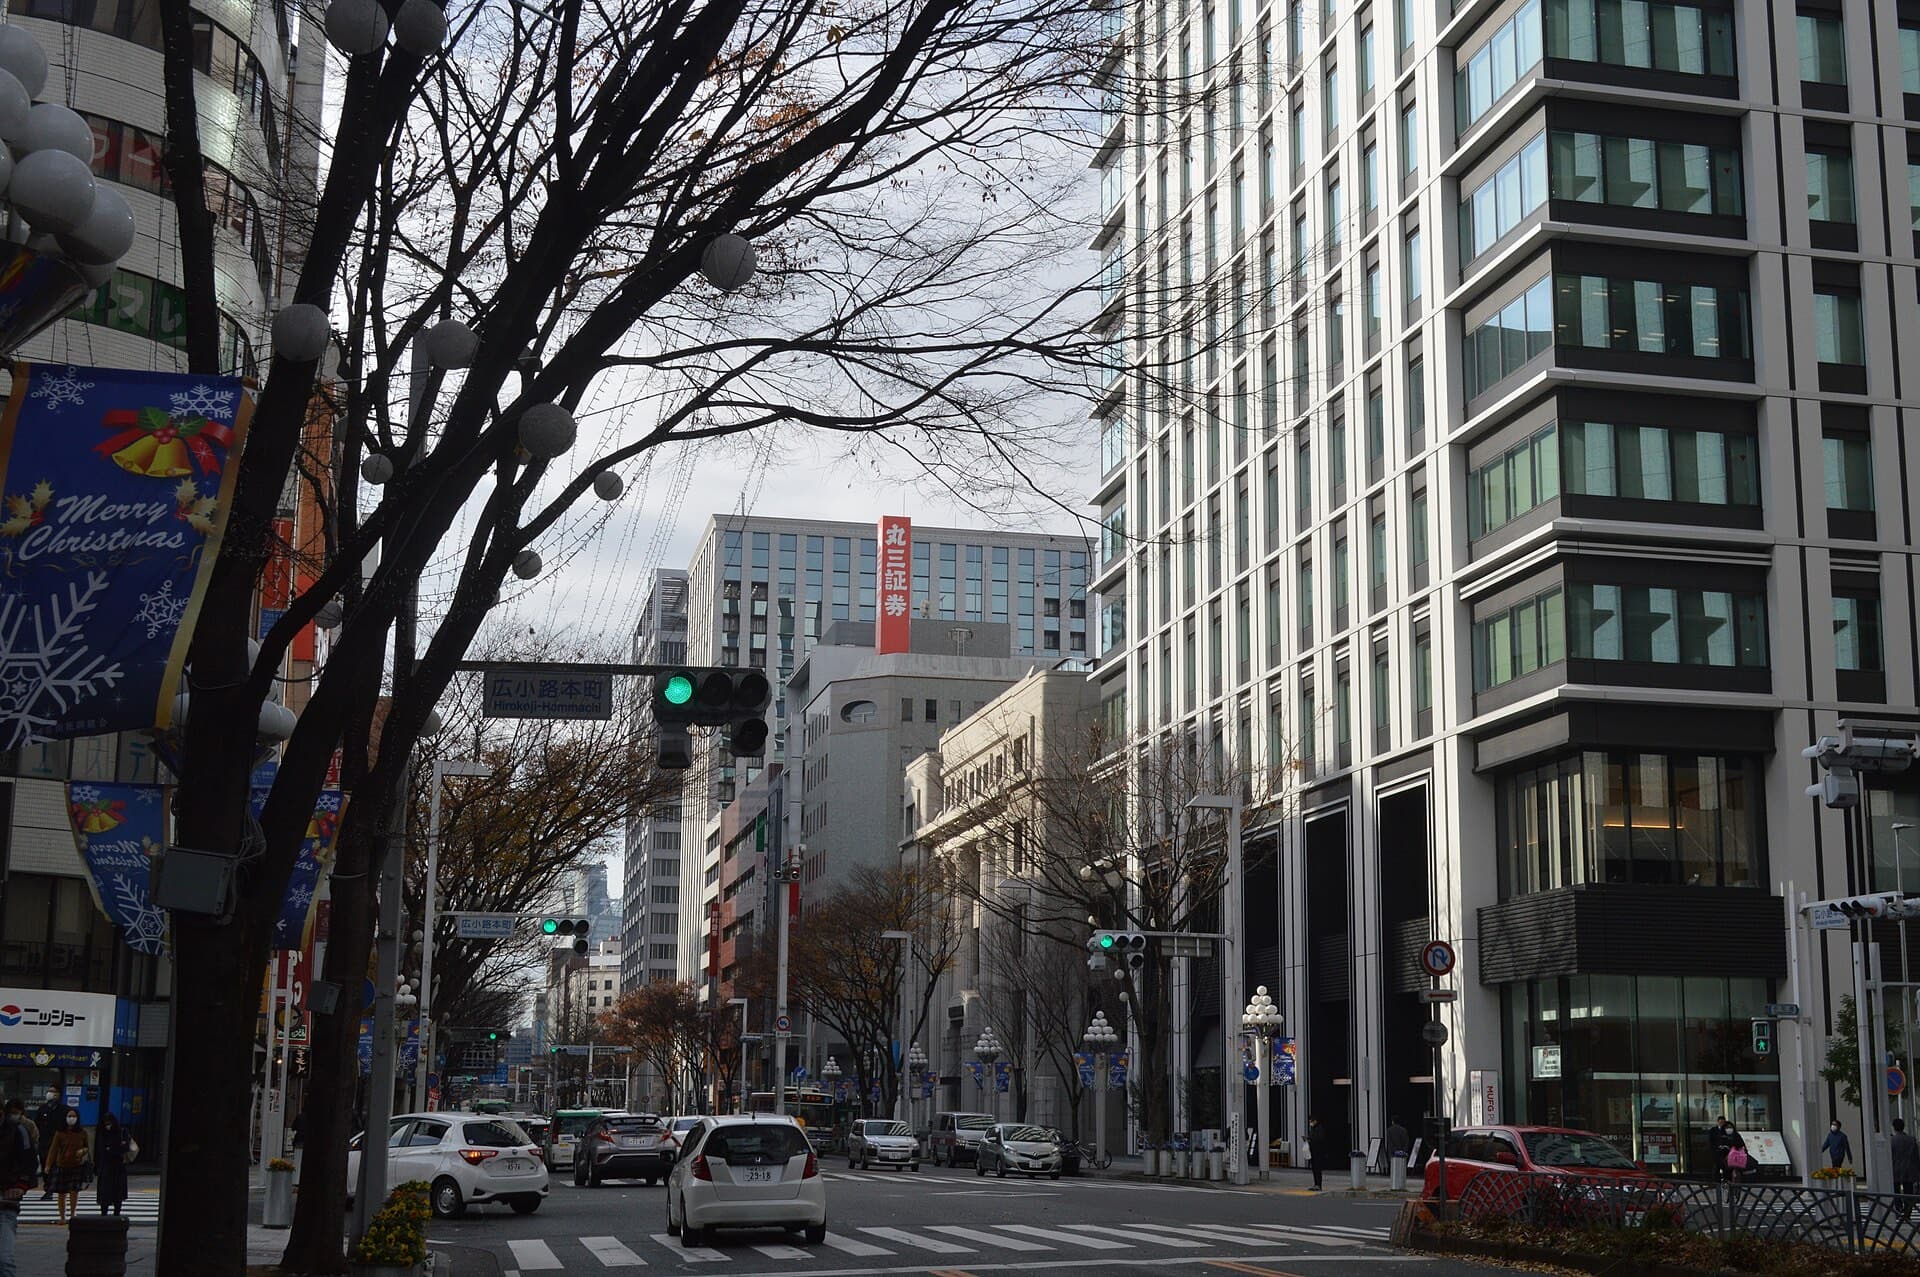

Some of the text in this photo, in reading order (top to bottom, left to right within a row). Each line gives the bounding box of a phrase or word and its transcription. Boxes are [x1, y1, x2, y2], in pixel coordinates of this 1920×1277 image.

[56, 494, 168, 526] Merry
[18, 525, 186, 561] Christmas
[884, 523, 907, 617] 丸三証券
[492, 678, 602, 699] 広小路本町
[494, 700, 601, 713] Hirokoji-Hommachi
[23, 1009, 86, 1027] ニッショー
